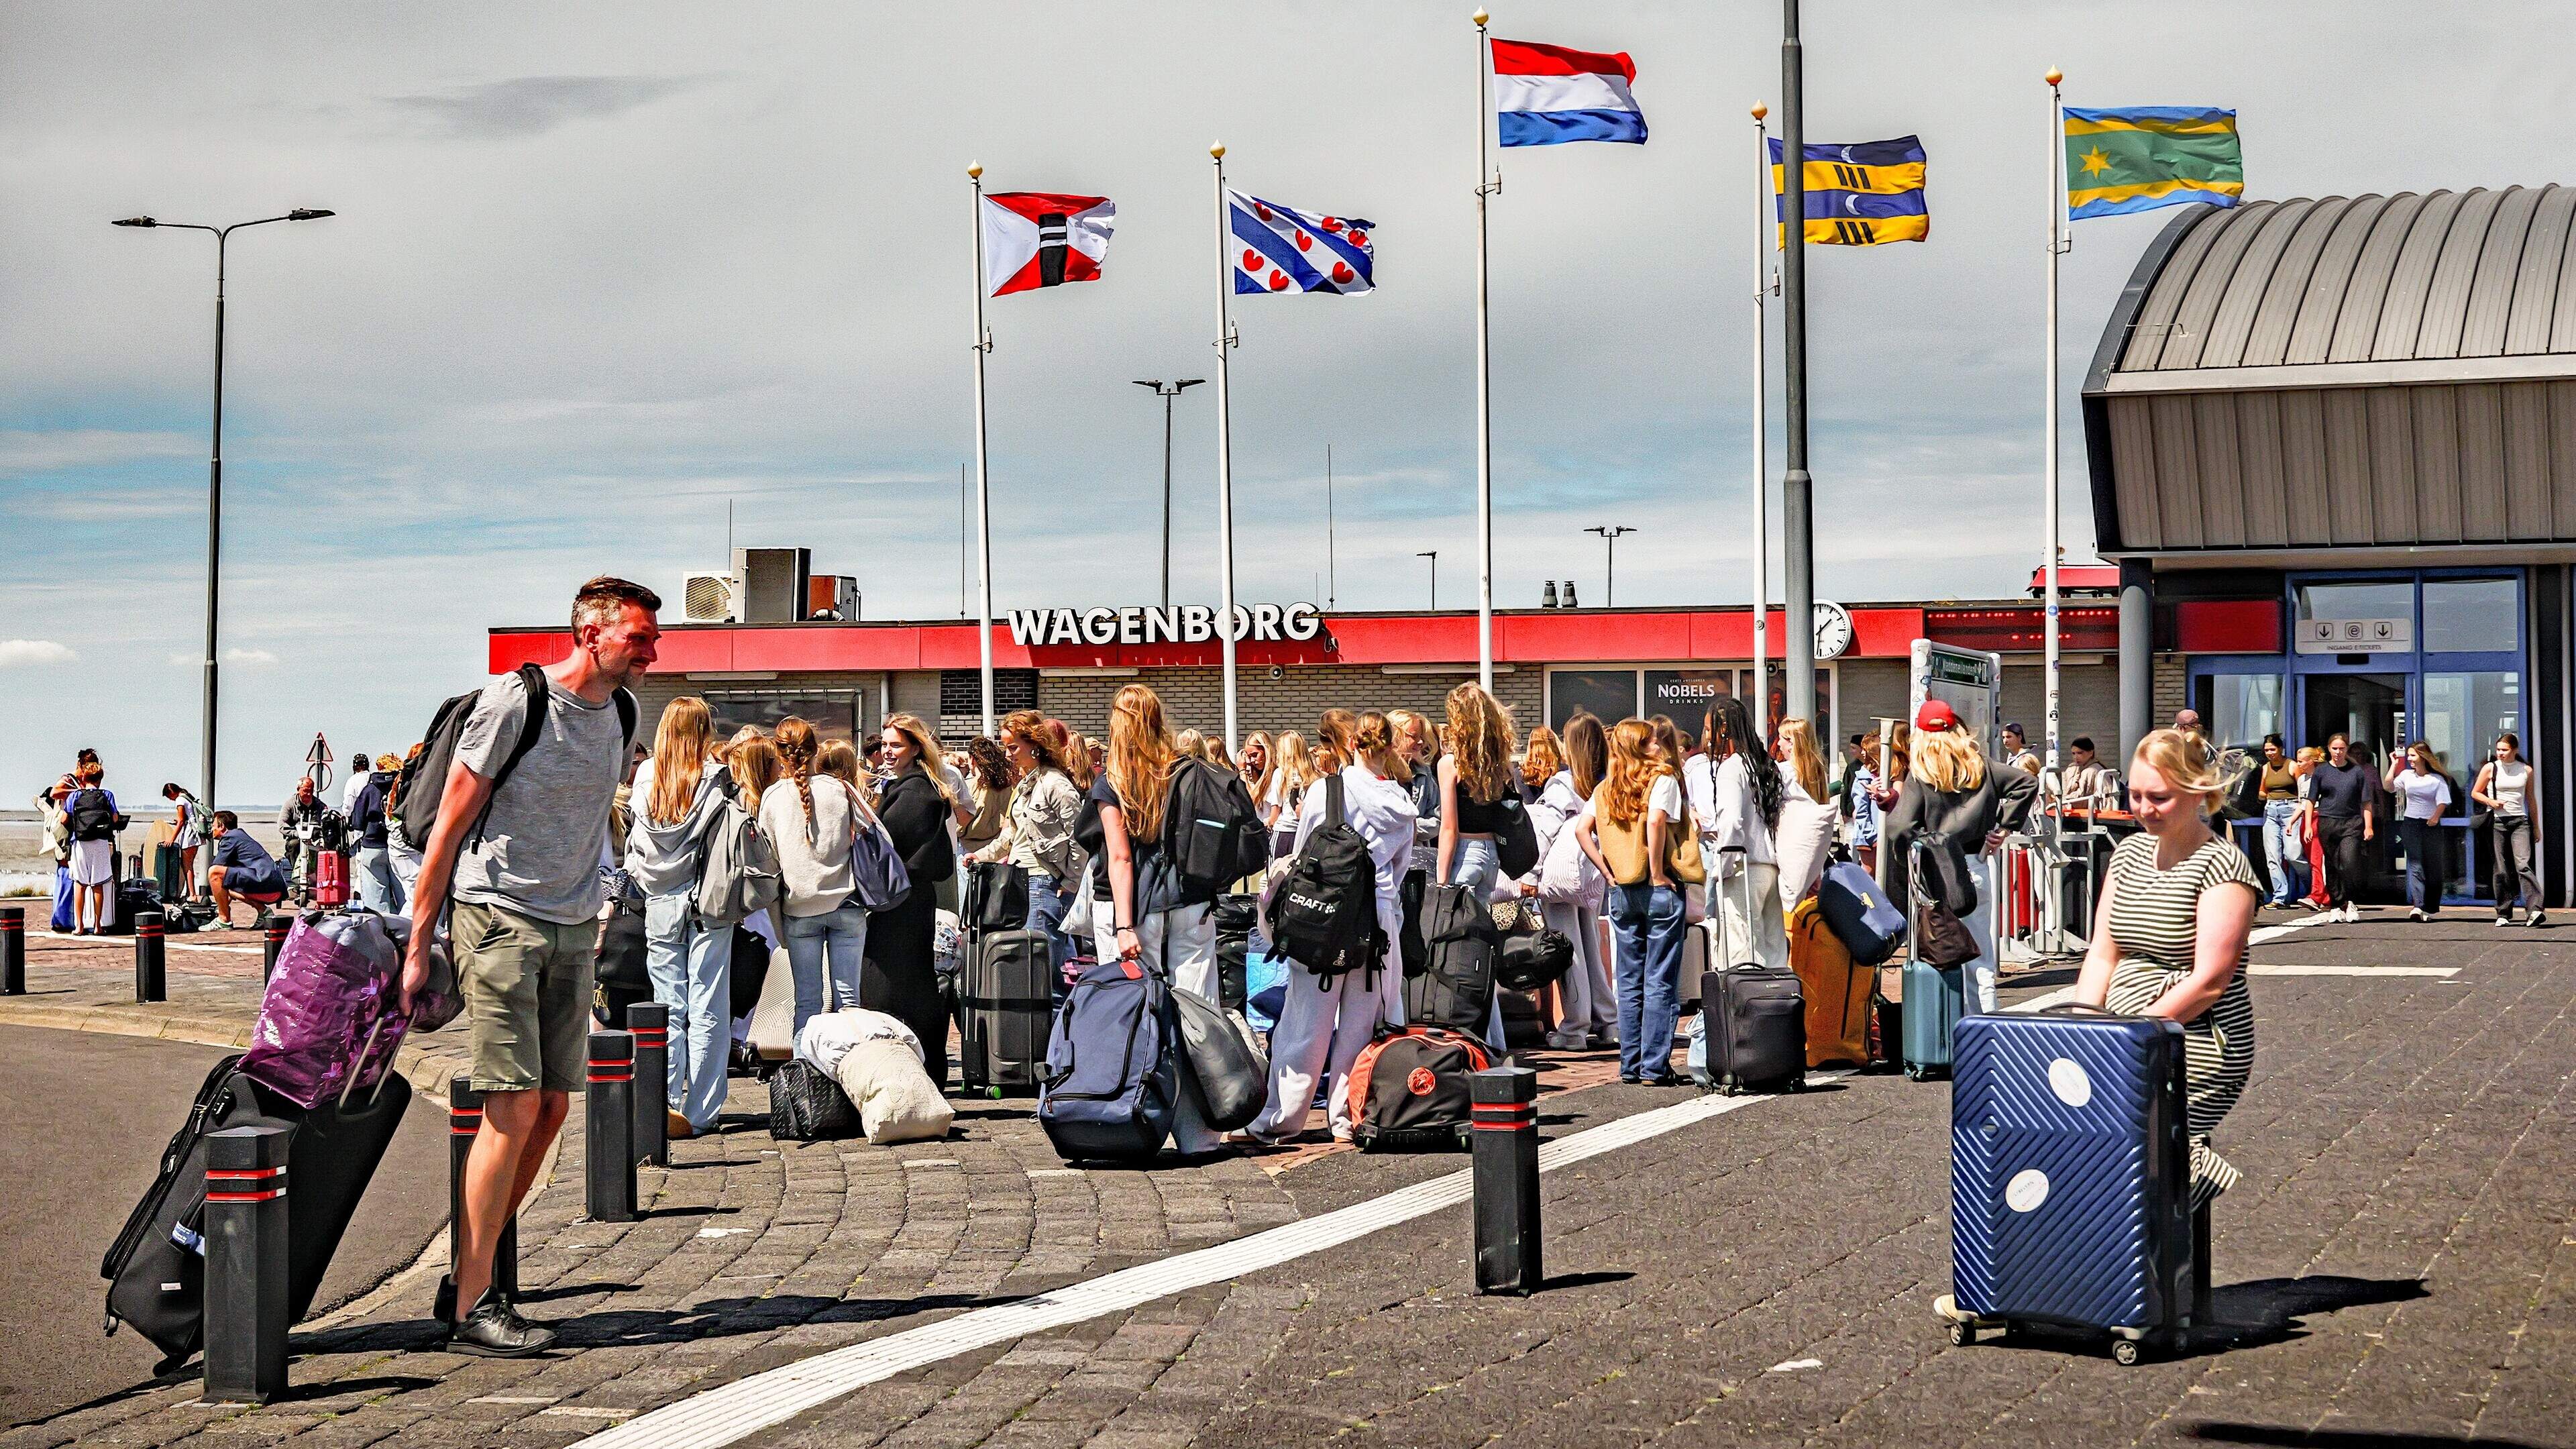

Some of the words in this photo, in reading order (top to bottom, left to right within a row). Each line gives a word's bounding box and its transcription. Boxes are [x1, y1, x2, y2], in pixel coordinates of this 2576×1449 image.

[1006, 602, 1320, 645] WAGENBORG
[1658, 684, 1715, 698] NOBELS
[1289, 893, 1326, 911] CRAFT
